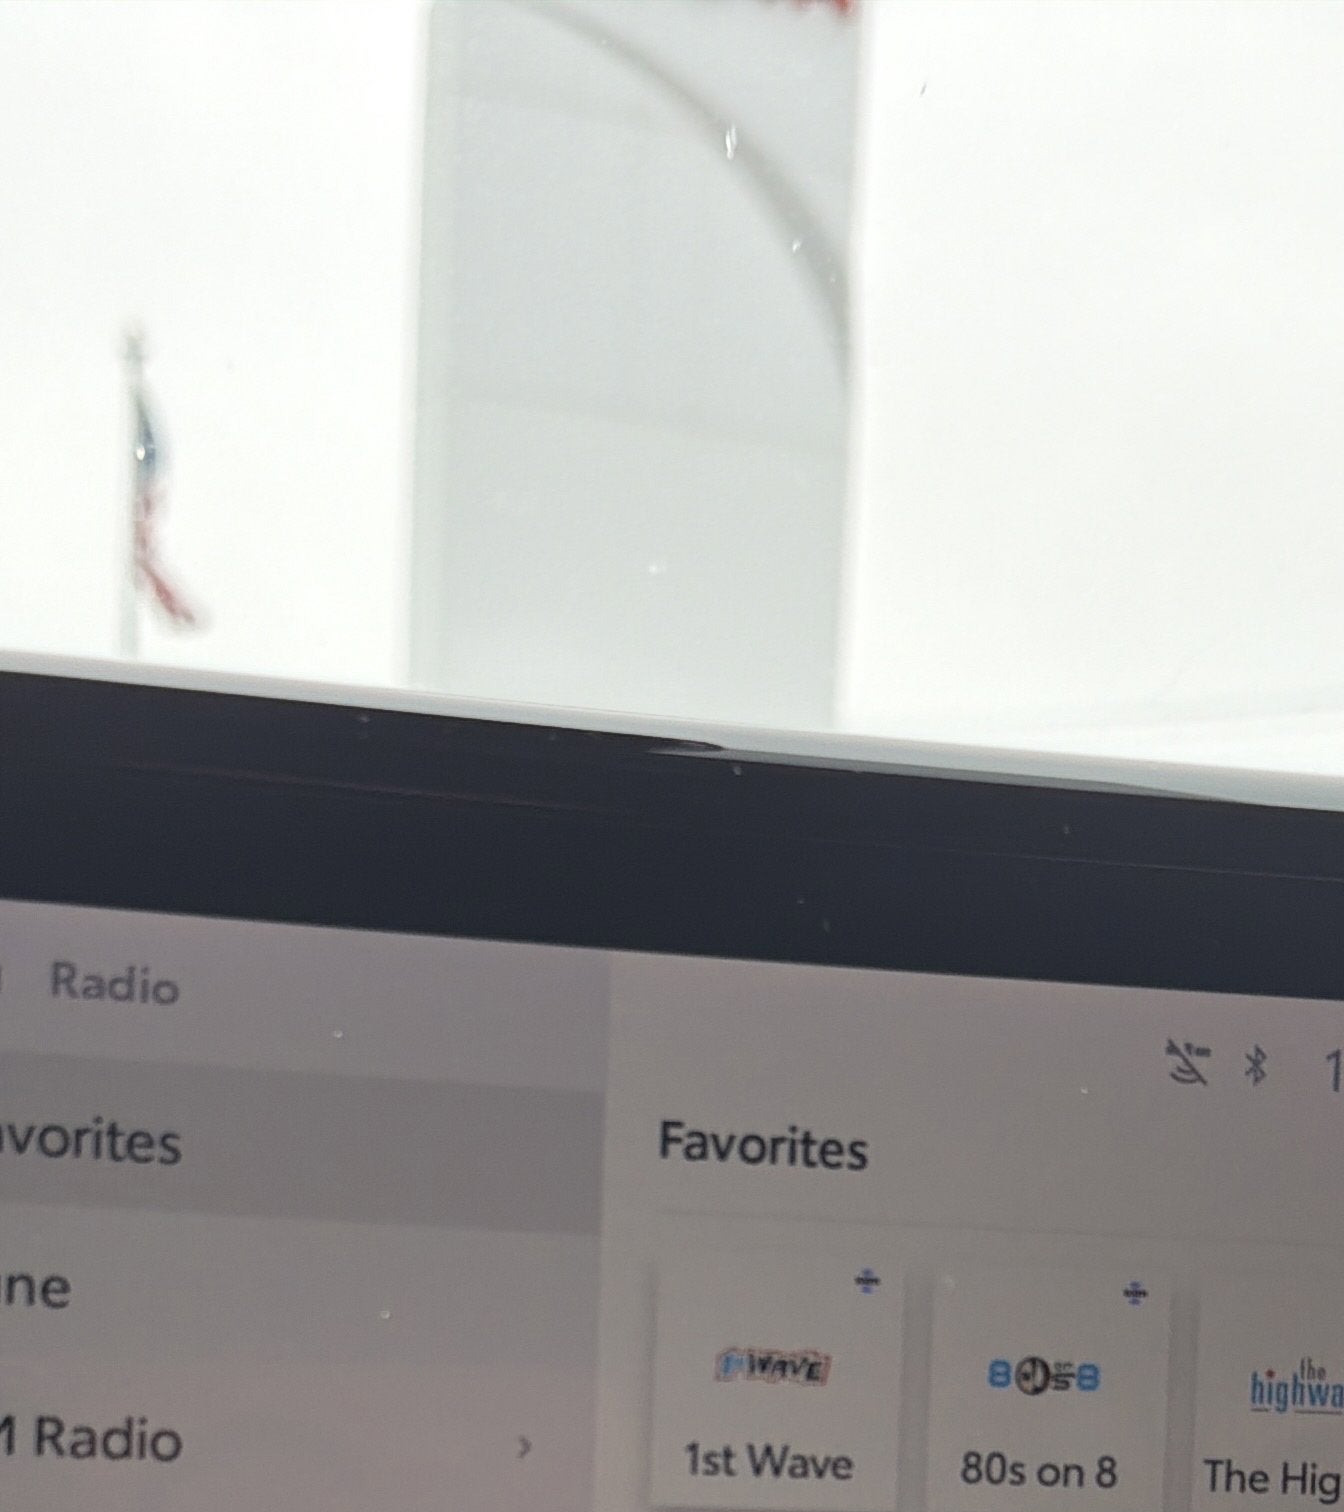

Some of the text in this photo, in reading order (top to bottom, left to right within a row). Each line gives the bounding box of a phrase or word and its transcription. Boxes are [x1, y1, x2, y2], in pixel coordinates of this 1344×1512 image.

[50, 960, 180, 1006] Radio
[659, 1119, 869, 1171] Favorites
[1299, 1357, 1327, 1382] the
[35, 1415, 183, 1463] Radio
[686, 1442, 854, 1481] 1st Wave
[960, 1450, 1118, 1490] 80s on 8
[1203, 1458, 1270, 1494] The
